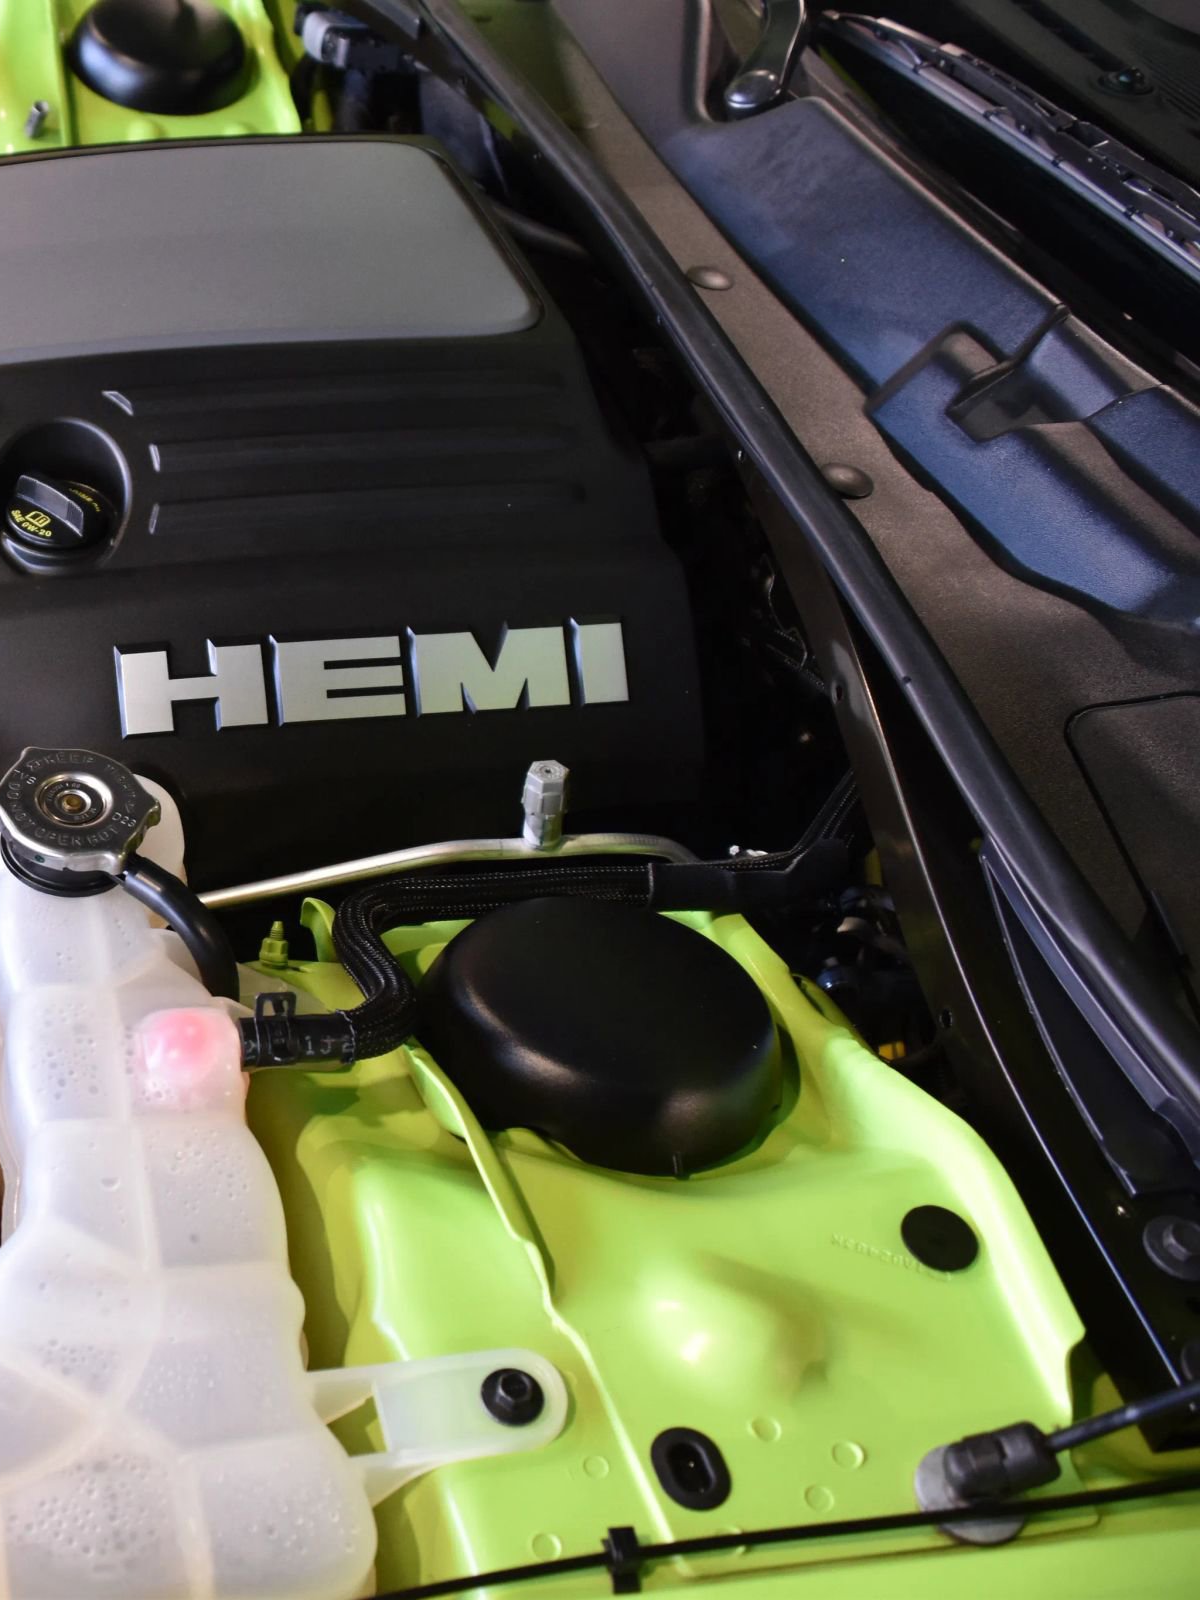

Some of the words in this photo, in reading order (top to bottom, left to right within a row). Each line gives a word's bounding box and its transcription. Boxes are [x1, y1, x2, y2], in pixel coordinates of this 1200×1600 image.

[11, 509, 26, 523] SAE
[21, 521, 52, 537] 0W-20
[114, 616, 629, 740] HEMI
[112, 811, 137, 829] D23
